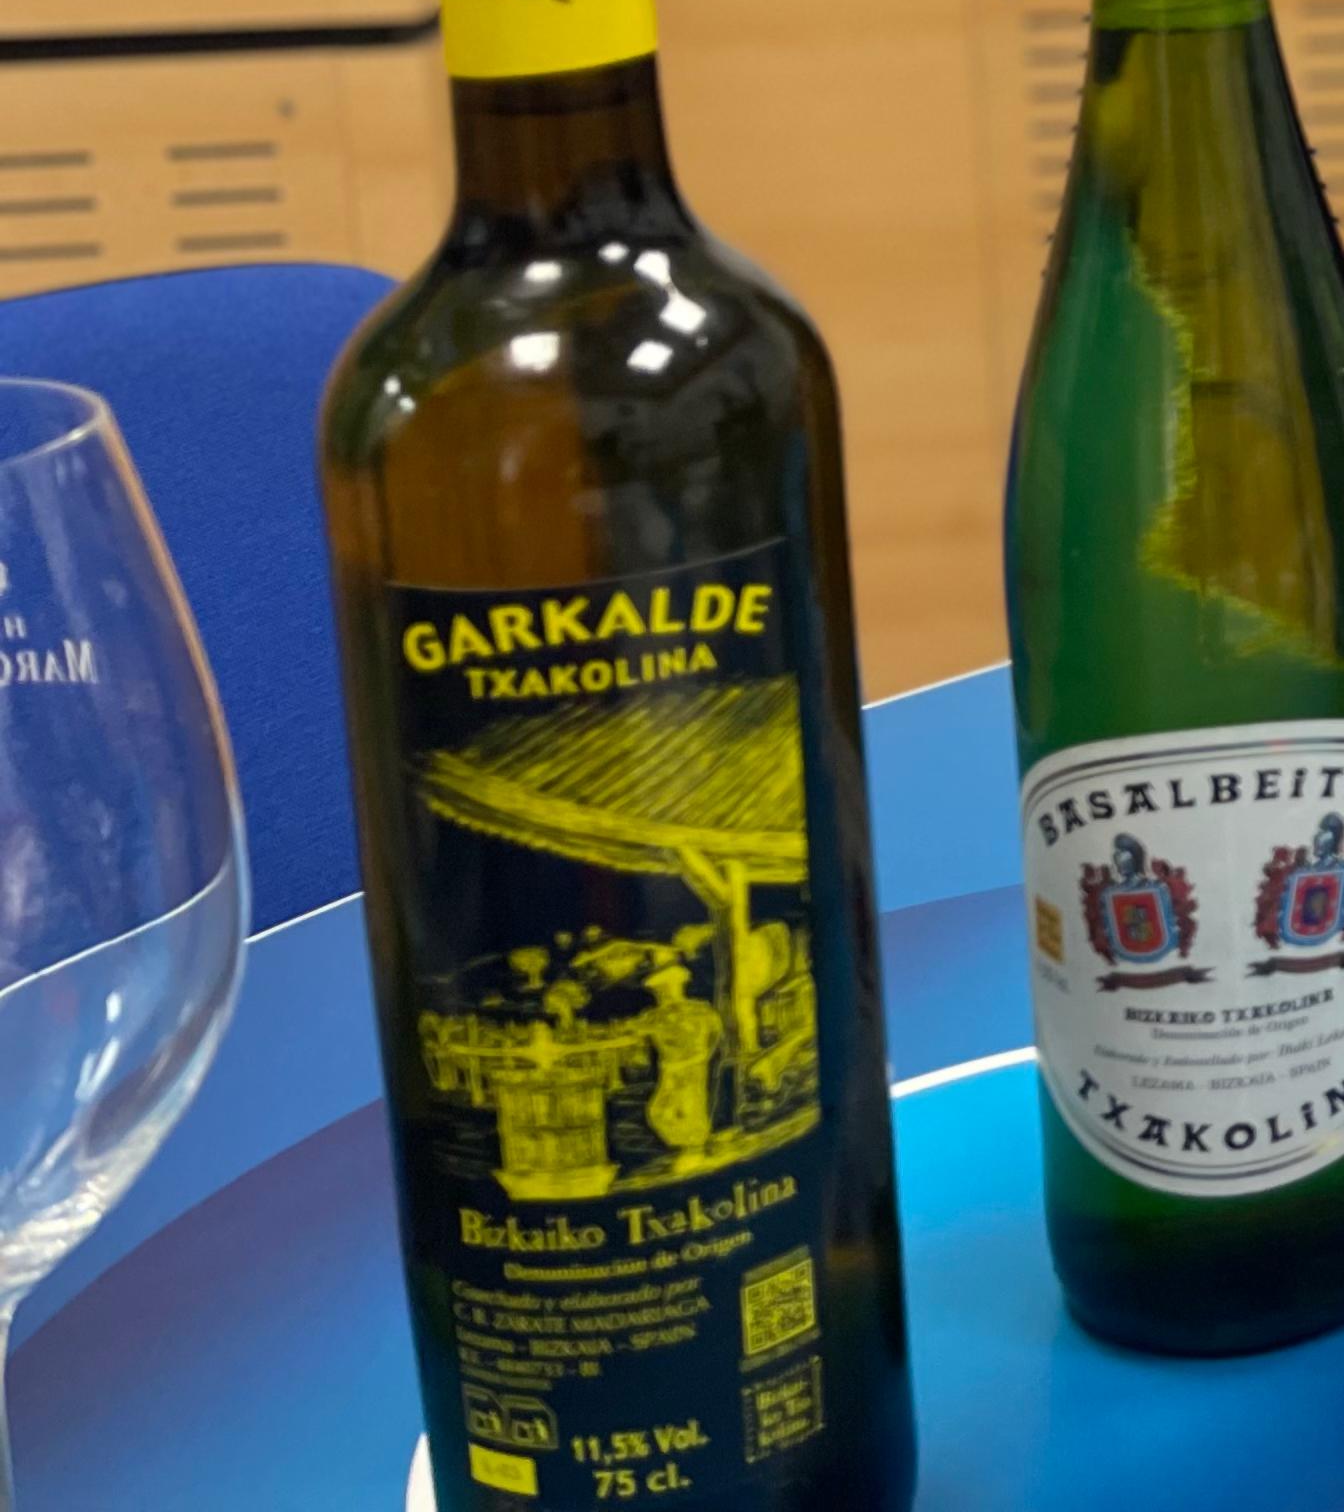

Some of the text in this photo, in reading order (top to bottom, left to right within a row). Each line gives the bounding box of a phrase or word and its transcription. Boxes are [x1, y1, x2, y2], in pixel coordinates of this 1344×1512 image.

[403, 584, 772, 673] GARKALDE
[464, 643, 718, 700] TXAKOLINA
[616, 1174, 798, 1246] Txakolina
[593, 1469, 637, 1499] 75
